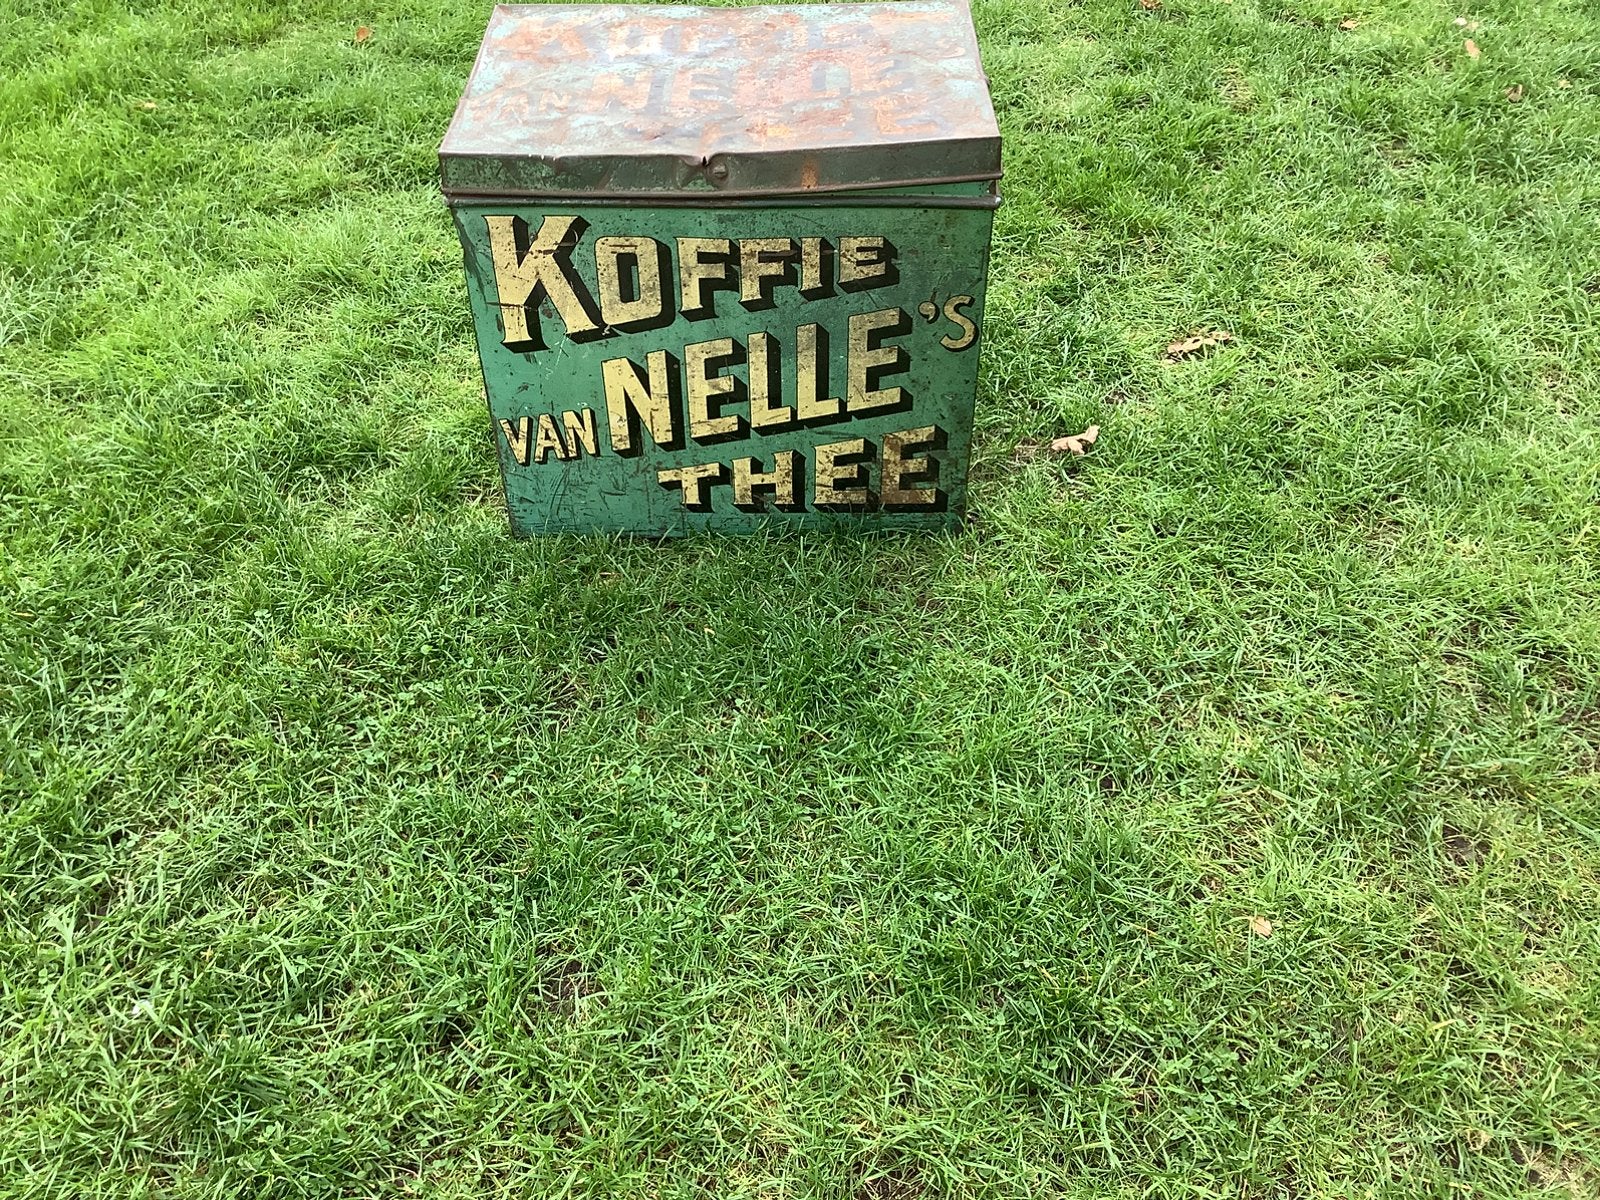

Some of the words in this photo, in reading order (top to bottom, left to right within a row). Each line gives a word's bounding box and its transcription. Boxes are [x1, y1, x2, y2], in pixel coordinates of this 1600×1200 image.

[484, 215, 899, 353] KOFFIE
[499, 407, 601, 466] VAN
[658, 424, 948, 513] THEE
